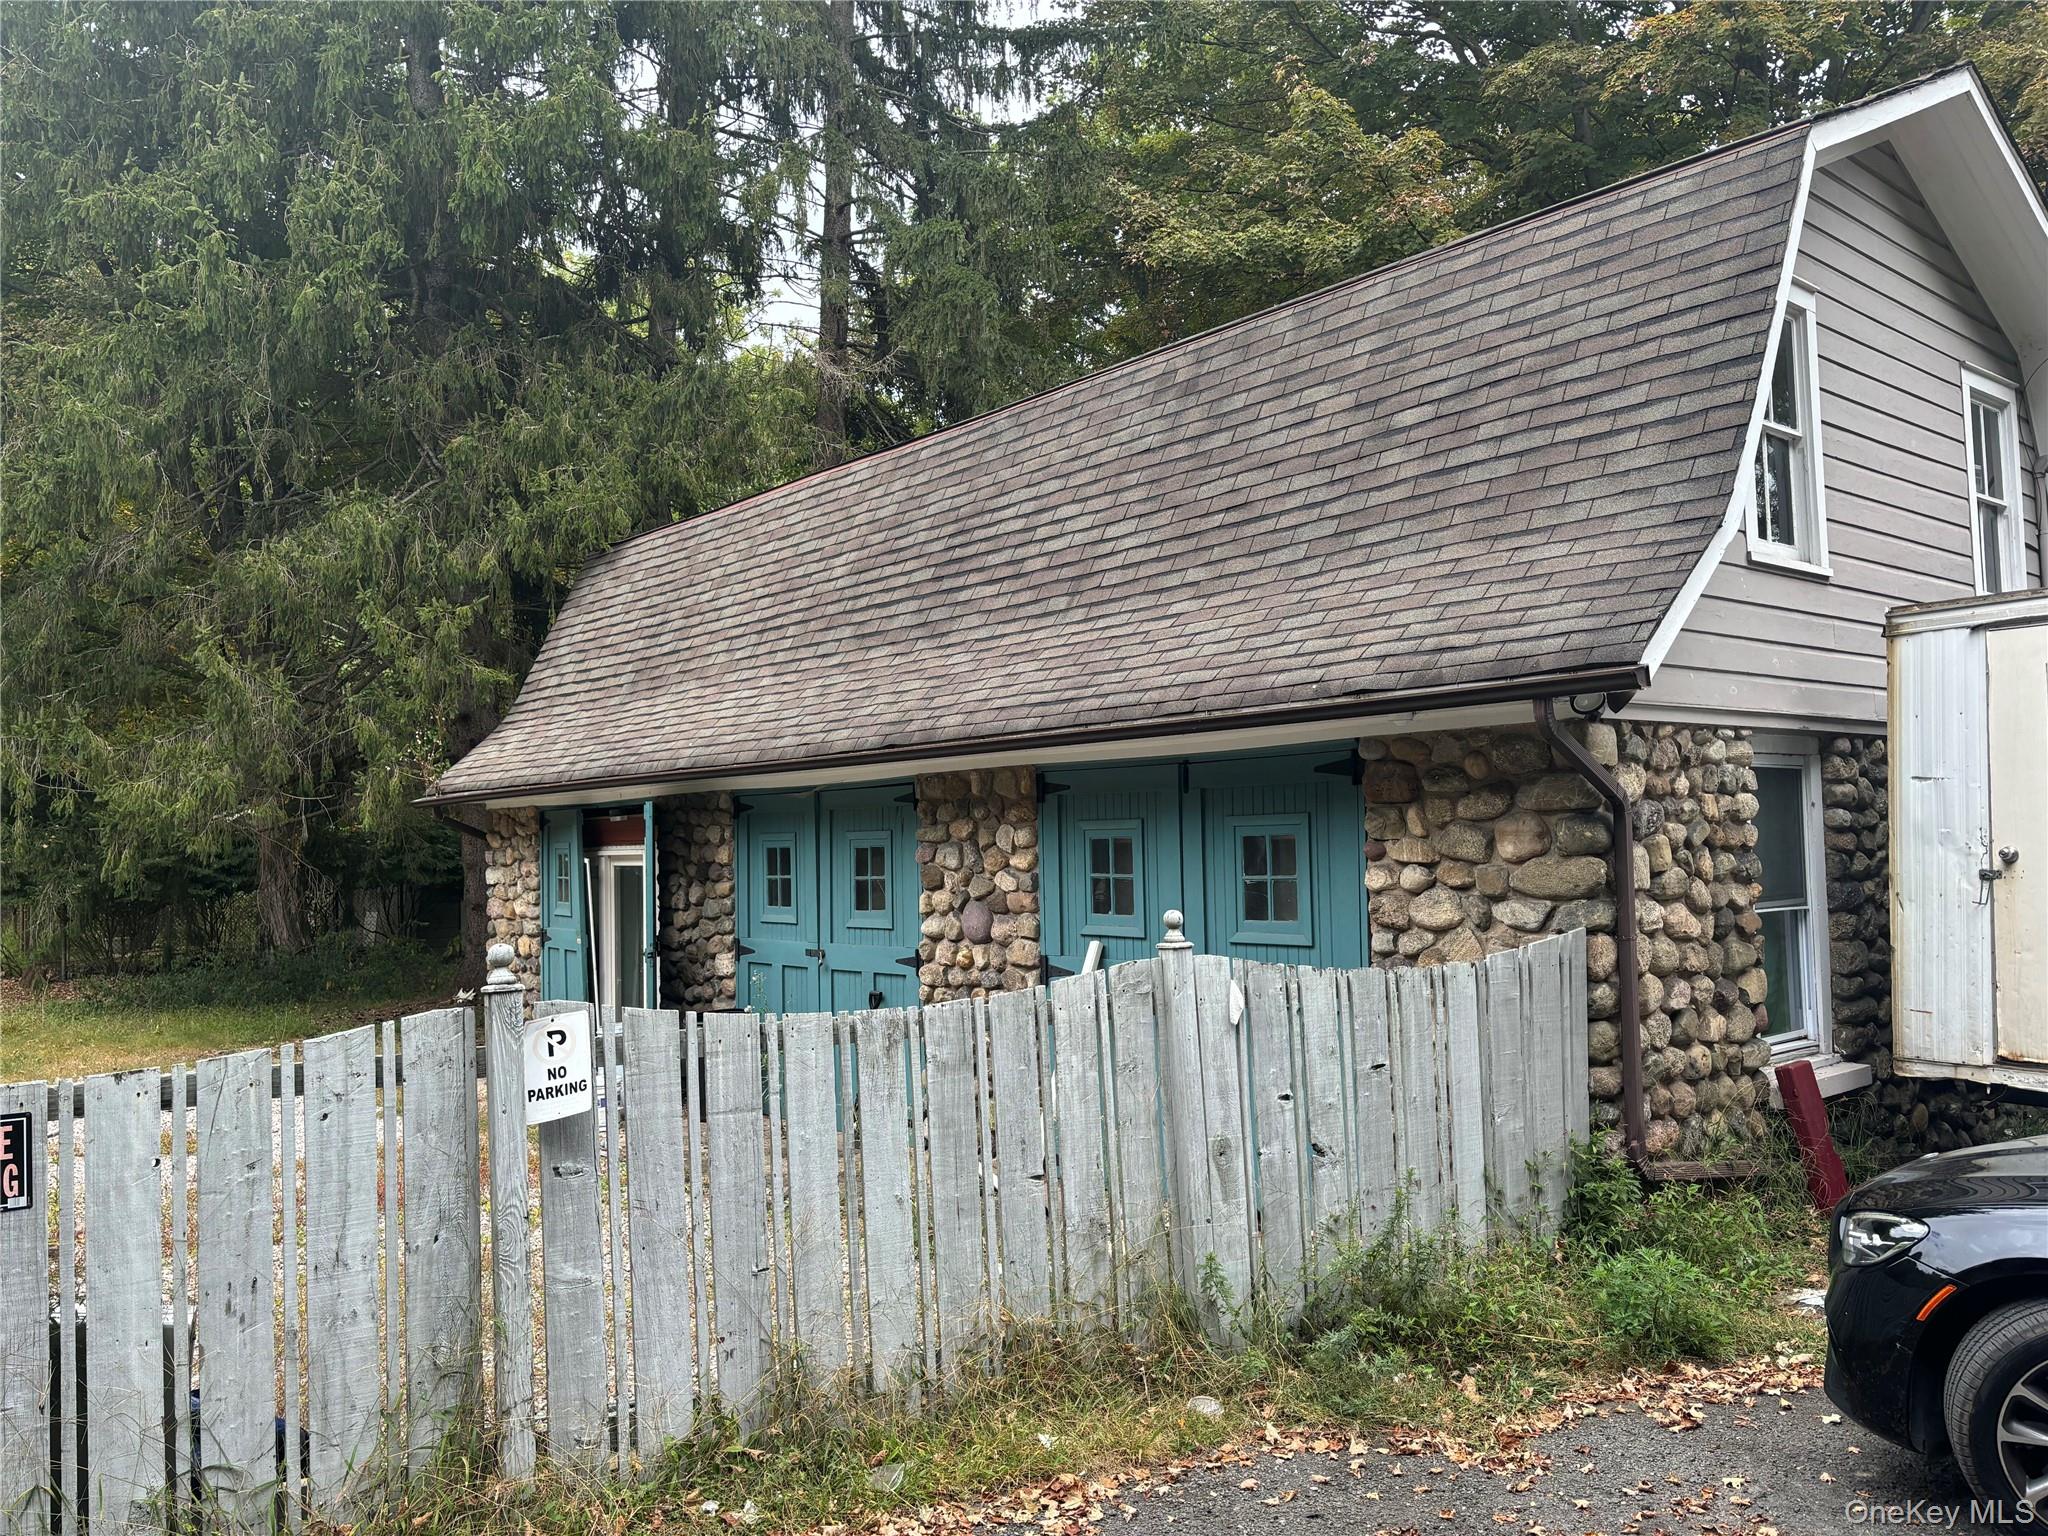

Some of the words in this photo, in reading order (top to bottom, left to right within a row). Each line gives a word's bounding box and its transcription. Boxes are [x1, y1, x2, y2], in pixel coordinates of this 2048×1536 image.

[546, 1029, 567, 1057] P
[547, 1066, 567, 1081] NO
[528, 1079, 587, 1102] PARKING
